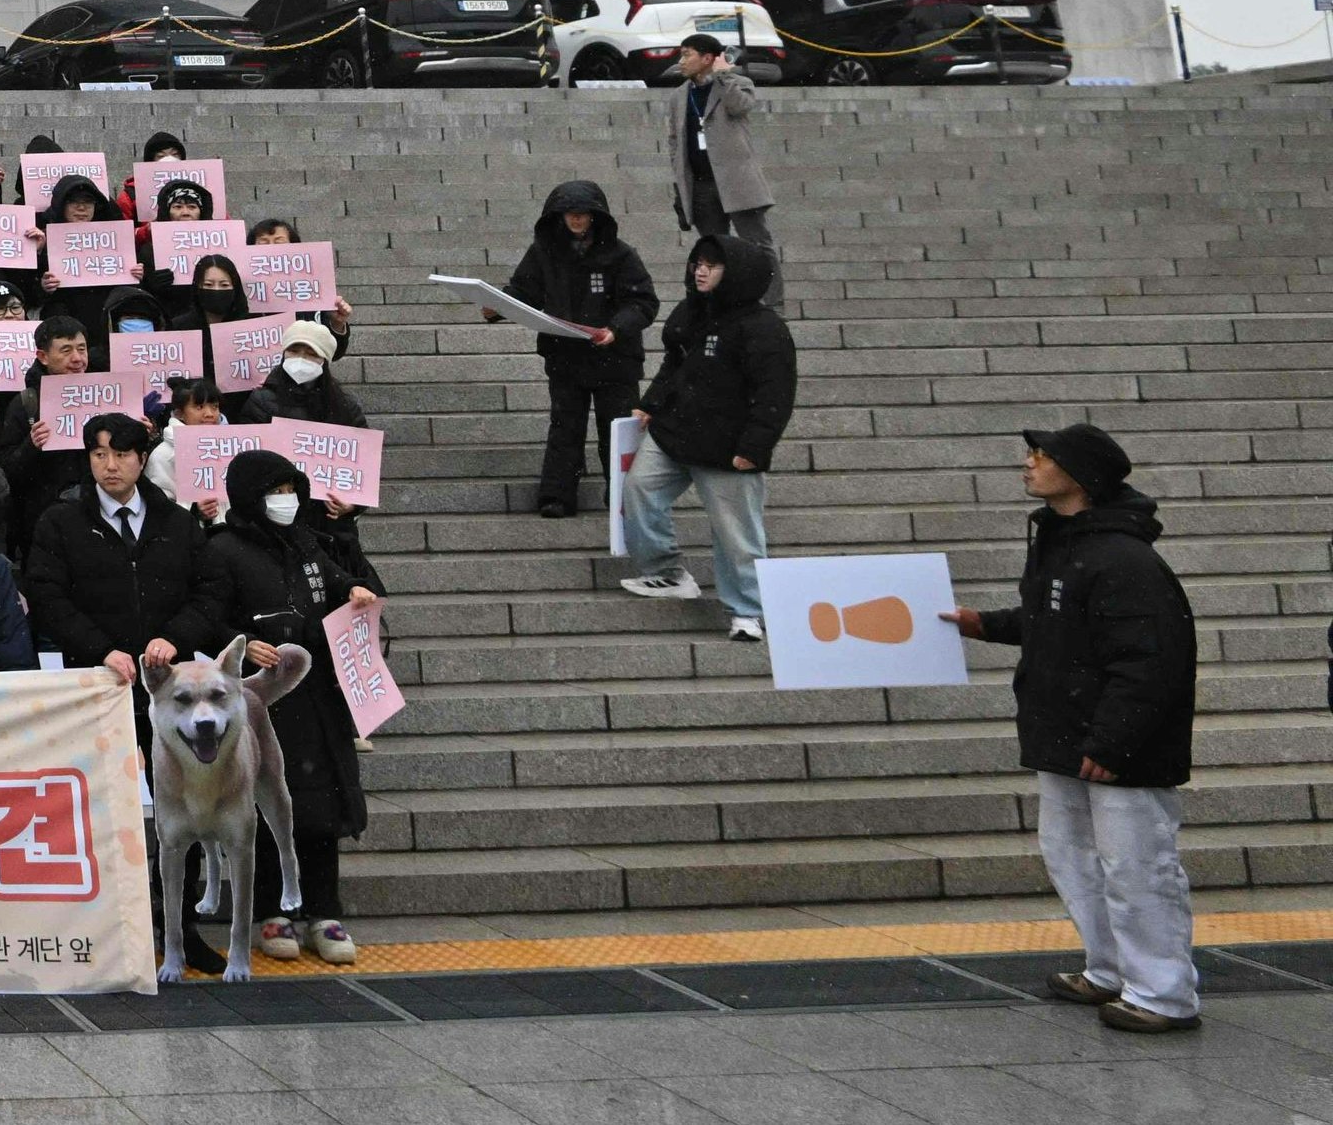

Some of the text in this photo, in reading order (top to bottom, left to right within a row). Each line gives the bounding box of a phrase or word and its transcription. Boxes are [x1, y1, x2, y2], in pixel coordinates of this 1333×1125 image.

[26, 166, 63, 179] 드디어
[65, 232, 116, 251] 굿바이
[173, 230, 228, 249] 굿바이
[62, 256, 124, 275] 개 식용!
[169, 255, 188, 274] 개
[250, 254, 311, 275] 굿바이
[247, 281, 319, 302] 개 식용!
[232, 326, 283, 353] 굿바이
[131, 342, 183, 365] 굿바이
[230, 359, 251, 380] 개
[61, 383, 121, 408] 굿바이
[56, 414, 76, 437] 개
[293, 431, 359, 462] 굿바이
[194, 466, 214, 490] 개
[17, 936, 63, 963] 계단
[69, 937, 94, 963] 앞
